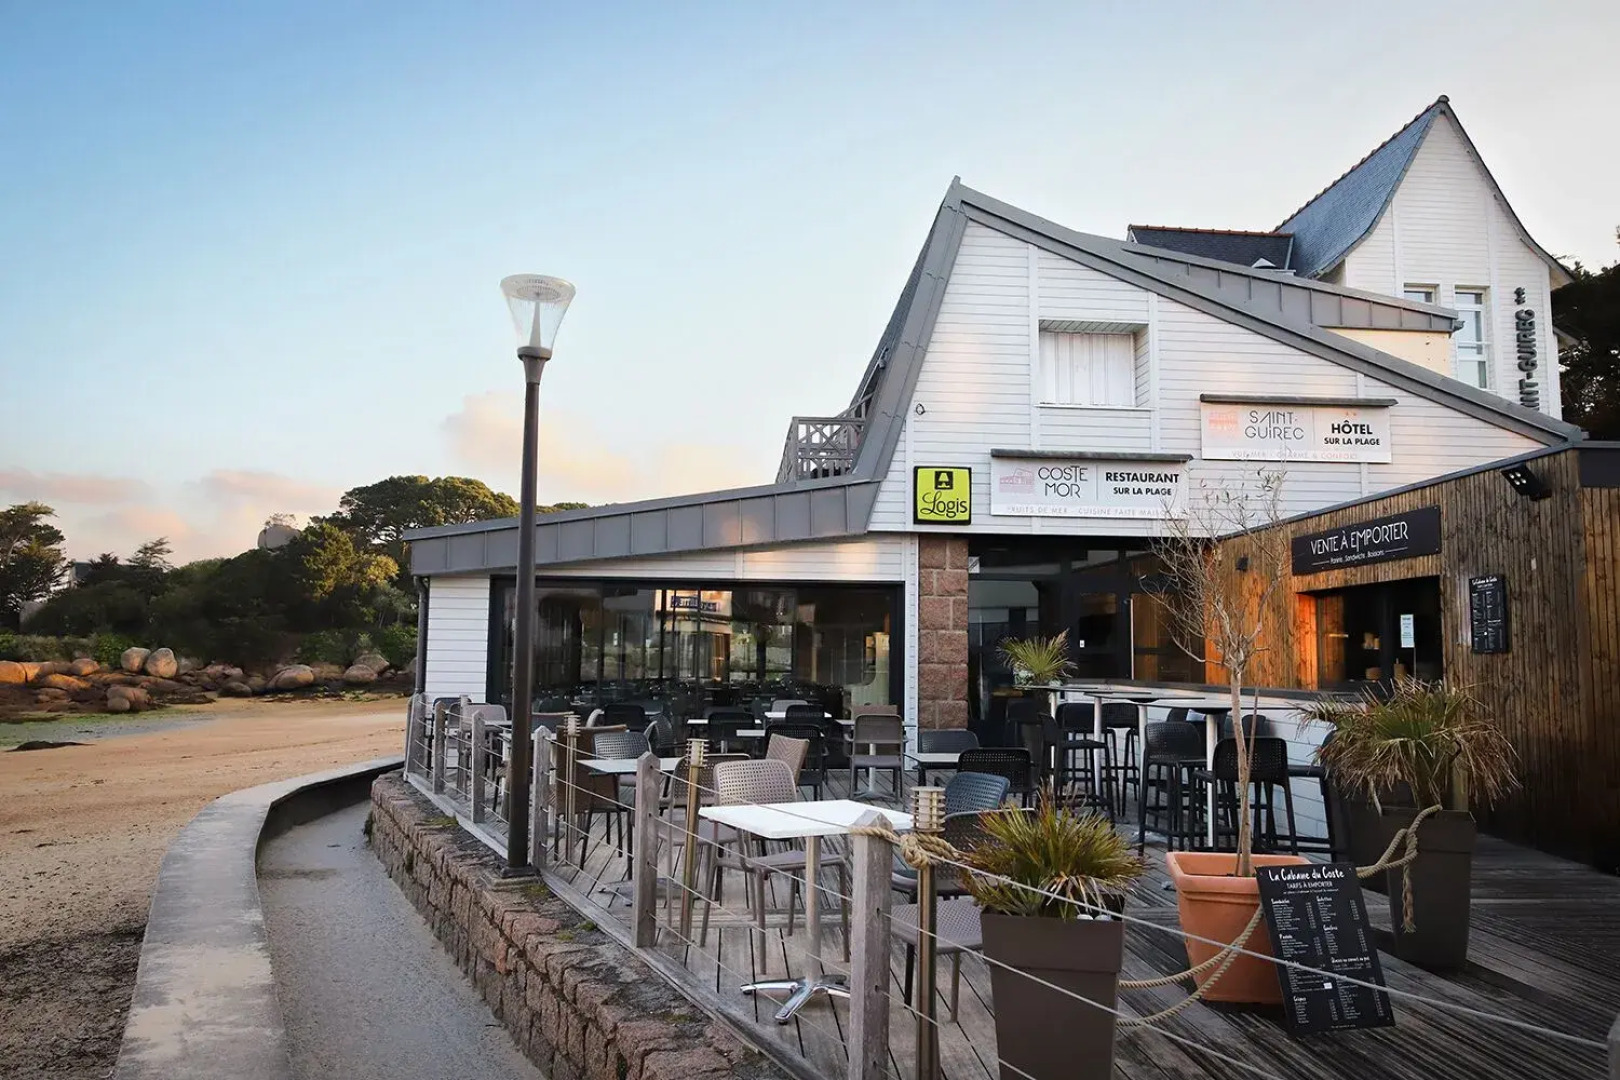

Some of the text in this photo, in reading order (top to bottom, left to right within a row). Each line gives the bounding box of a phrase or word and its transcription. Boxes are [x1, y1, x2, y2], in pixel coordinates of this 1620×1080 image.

[1515, 309, 1540, 412] INT-GUIREC
[1244, 426, 1304, 441] GUIREC
[1331, 419, 1374, 435] HÔTEL
[1324, 437, 1381, 446] SUR LA PLAGE
[1038, 465, 1088, 483] COSTE
[1105, 471, 1180, 484] RESTAURANT
[1044, 483, 1081, 499] MOR
[1113, 487, 1172, 496] SUR LA PLAGE
[920, 490, 968, 518] Logis
[1310, 521, 1409, 555] VENTE À EMPORTER
[1269, 869, 1281, 881] La
[1311, 868, 1321, 879] du
[1322, 866, 1345, 879] Coste
